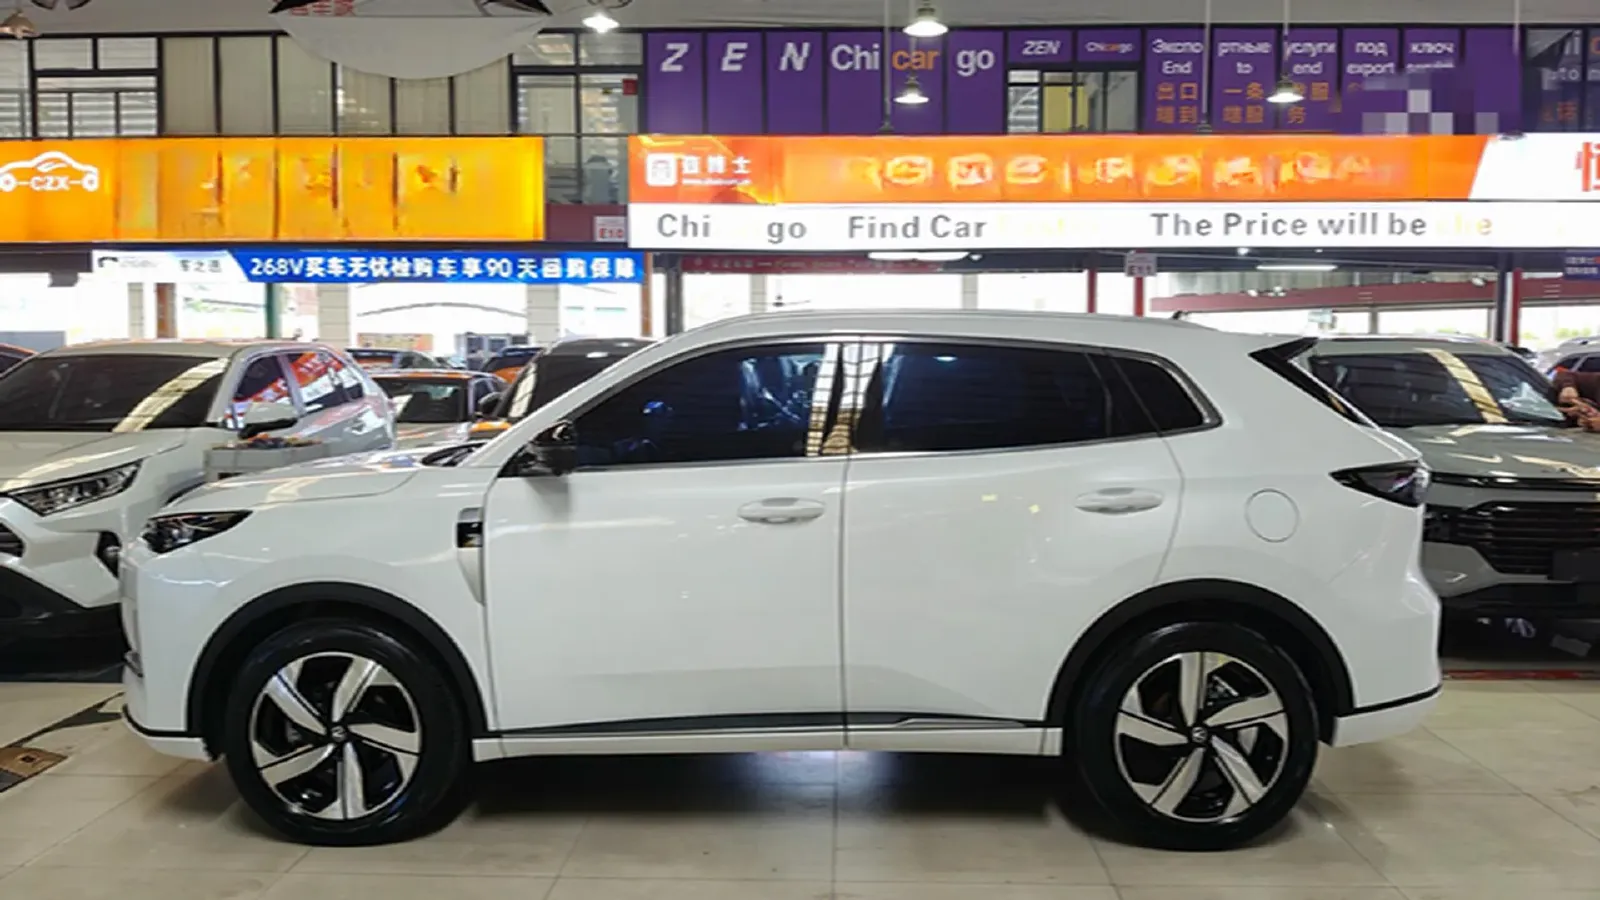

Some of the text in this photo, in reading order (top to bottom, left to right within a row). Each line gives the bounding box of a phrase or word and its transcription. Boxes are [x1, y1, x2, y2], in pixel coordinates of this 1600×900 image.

[1022, 40, 1061, 55] ZEN
[1355, 42, 1388, 57] под
[660, 42, 995, 77] Z E N Chi car go
[1162, 61, 1193, 74] End
[1236, 61, 1253, 74] to
[1292, 61, 1323, 74] end
[1346, 62, 1396, 77] export
[1157, 82, 1198, 100] 出口
[657, 213, 711, 238] Chi
[767, 221, 808, 245] go
[848, 215, 921, 239] Find
[930, 214, 988, 239] Car
[1150, 212, 1213, 236] The
[1223, 212, 1308, 236] Price
[1317, 212, 1379, 236] will
[1387, 212, 1427, 236] be
